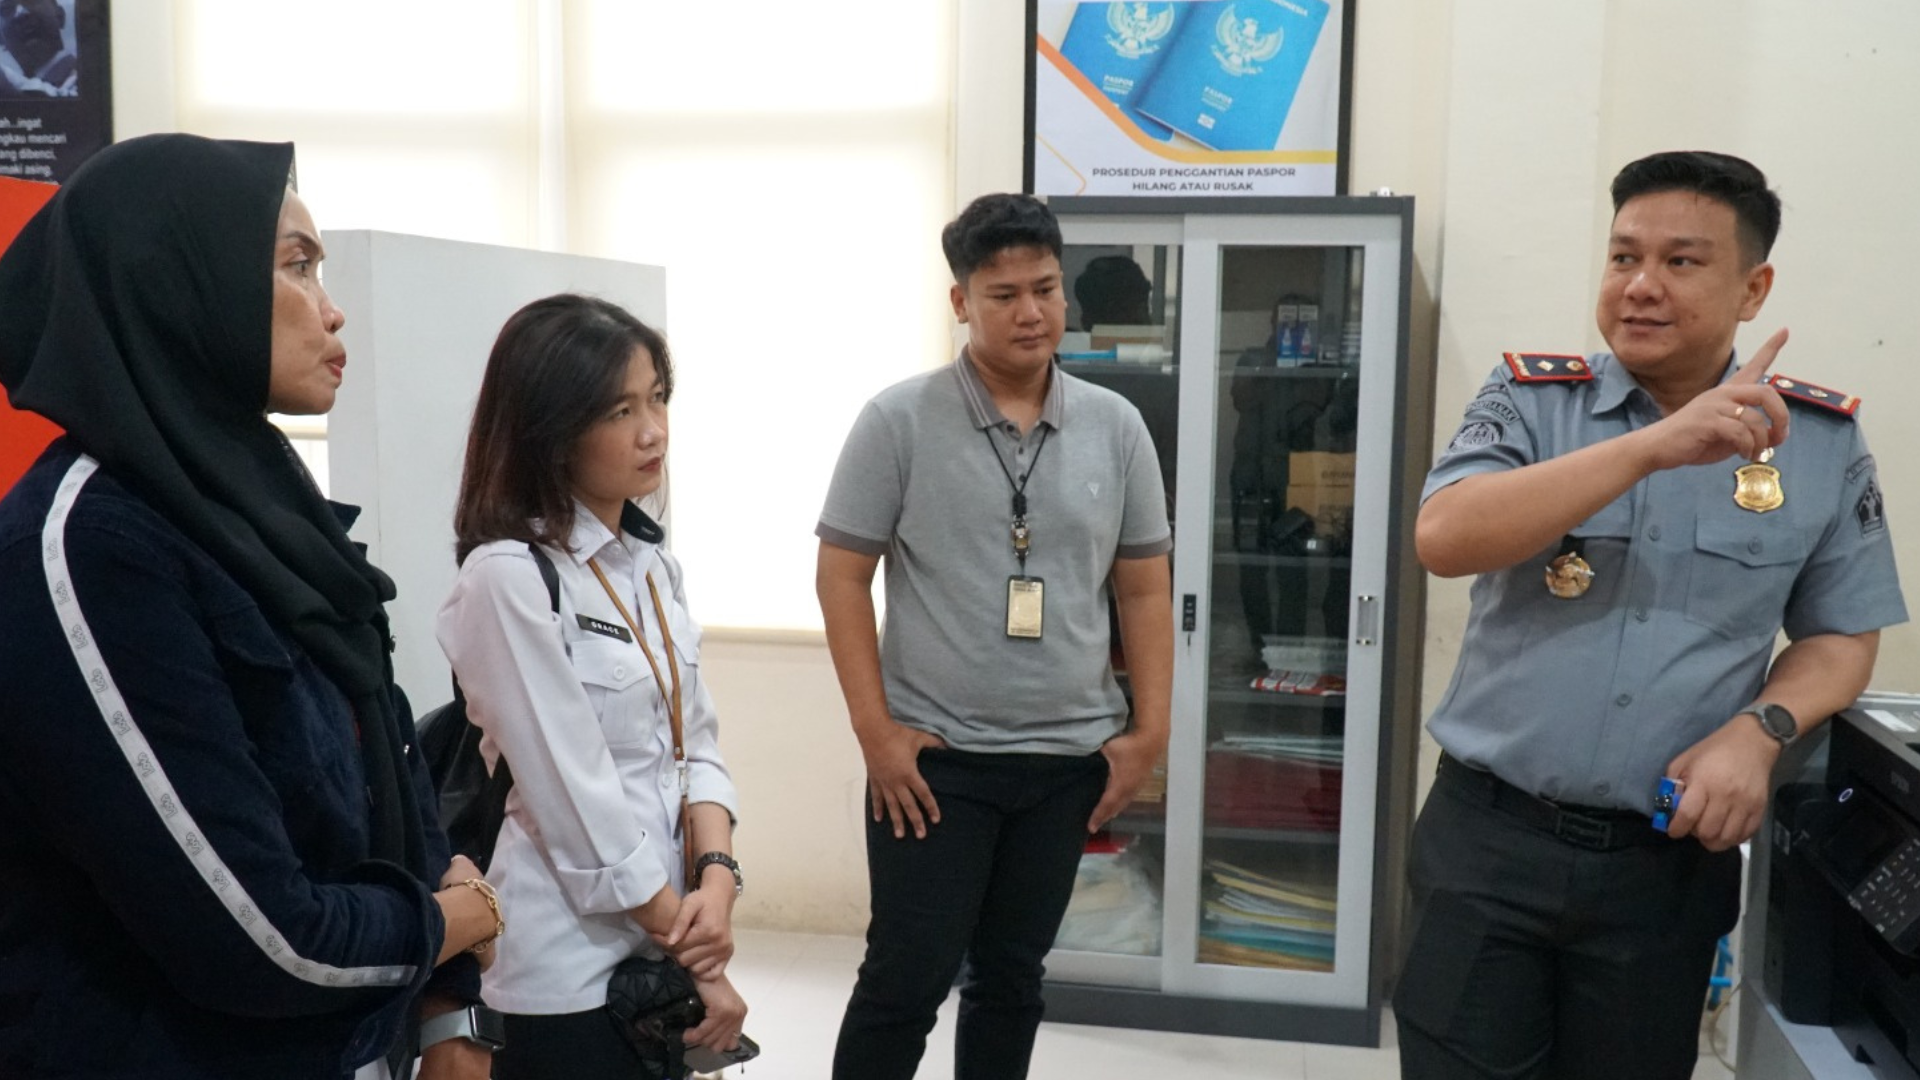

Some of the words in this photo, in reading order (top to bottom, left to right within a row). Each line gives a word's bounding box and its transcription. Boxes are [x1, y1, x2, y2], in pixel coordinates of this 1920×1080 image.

[28, 133, 67, 144] mencari
[1092, 168, 1156, 177] PROSEDUR
[1159, 168, 1244, 177] PENGGANTIAN
[1248, 168, 1296, 177] PASPOR
[1132, 181, 1176, 191] HILANG
[1179, 181, 1211, 191] ATAU
[1213, 181, 1253, 191] RUSAK
